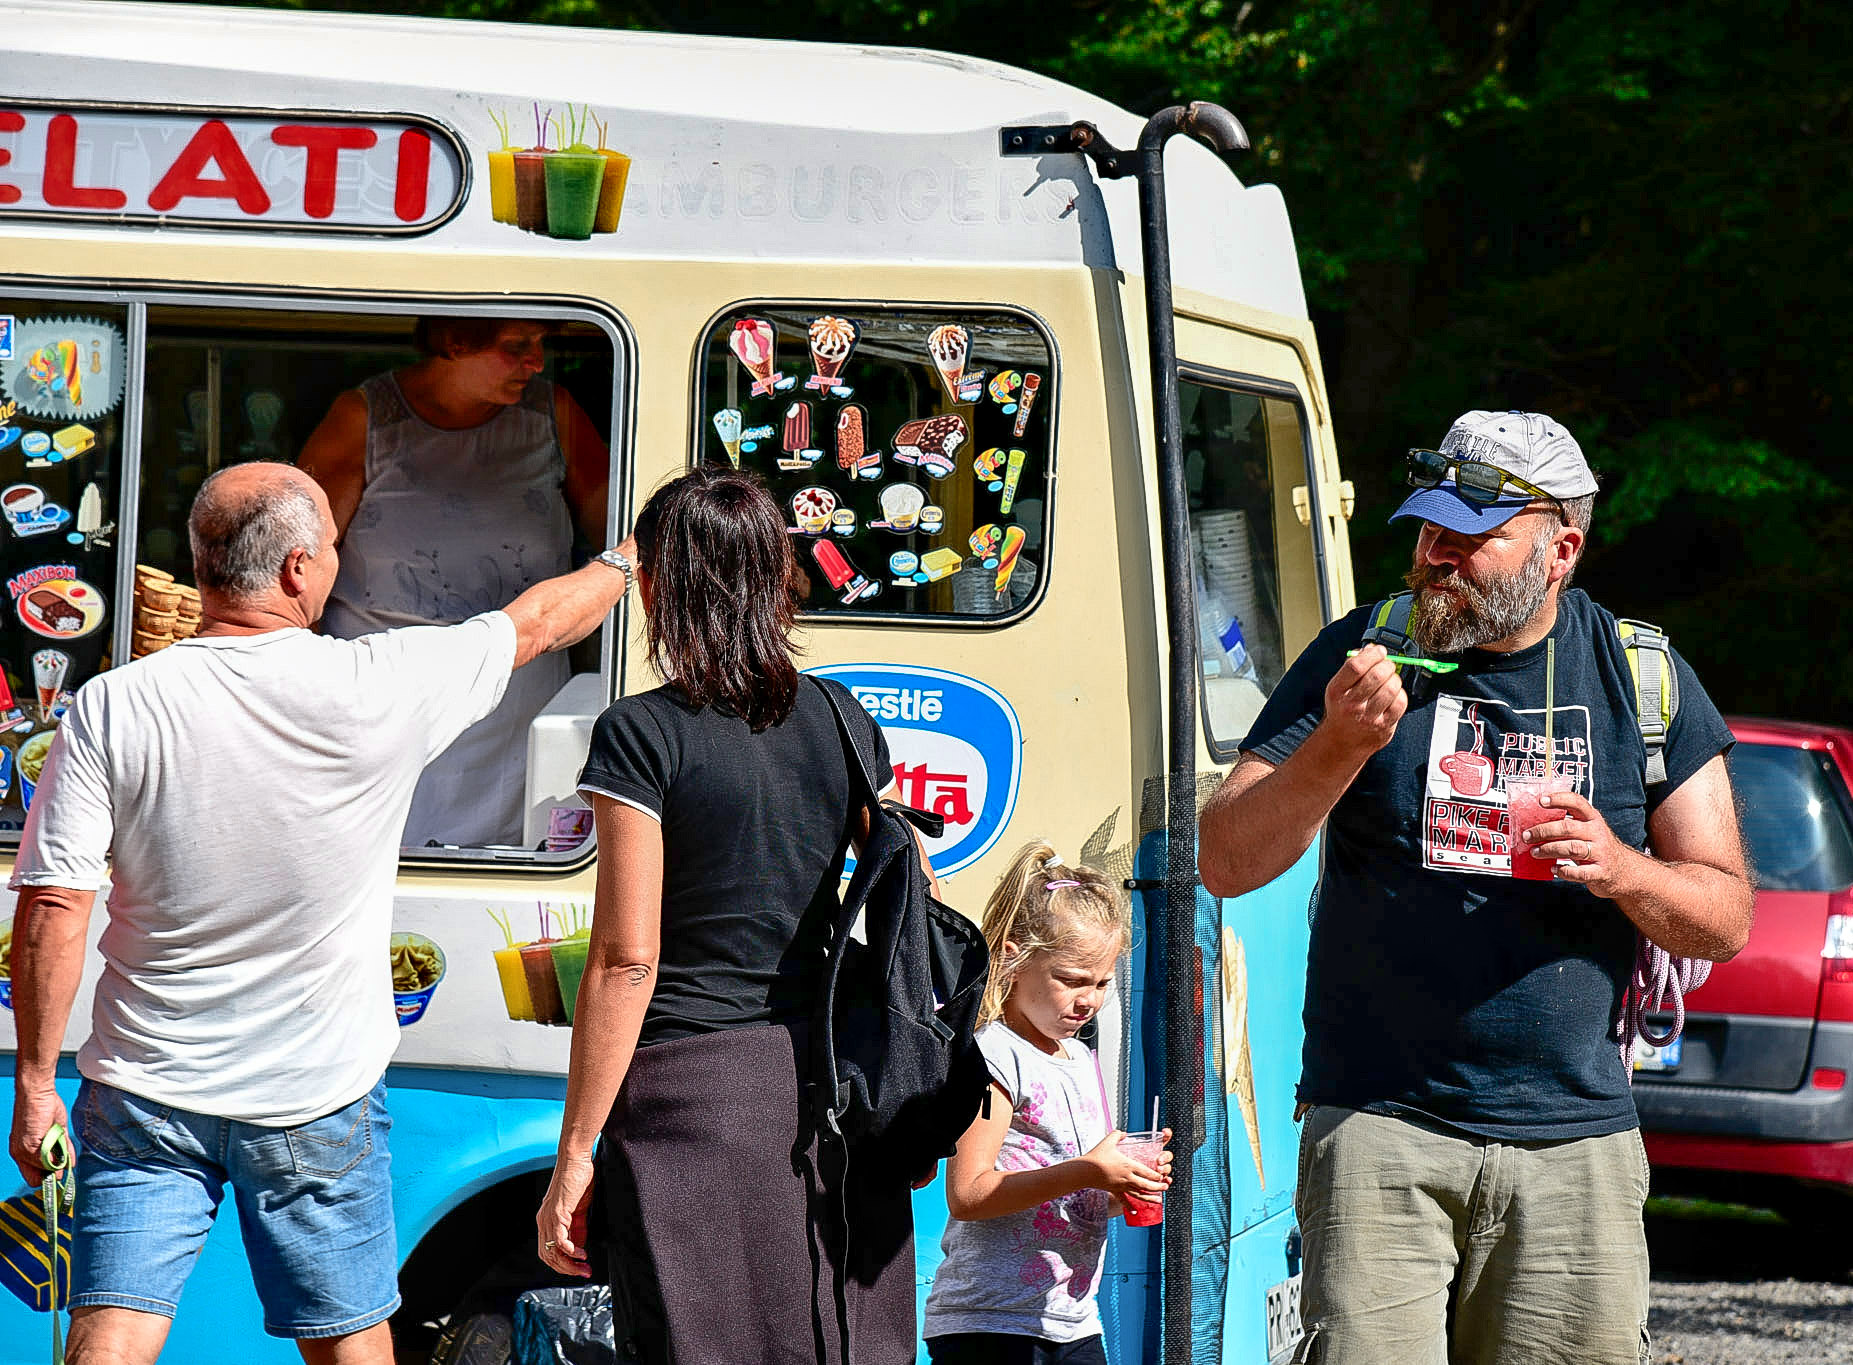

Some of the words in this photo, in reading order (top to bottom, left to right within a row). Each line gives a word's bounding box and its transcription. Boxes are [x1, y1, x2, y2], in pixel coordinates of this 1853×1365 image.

[7, 566, 76, 600] MAXIBON
[851, 686, 943, 722] estlé
[1503, 732, 1587, 756] PUBLIC
[1498, 756, 1589, 781] MARKET
[1432, 804, 1491, 830] PIKE
